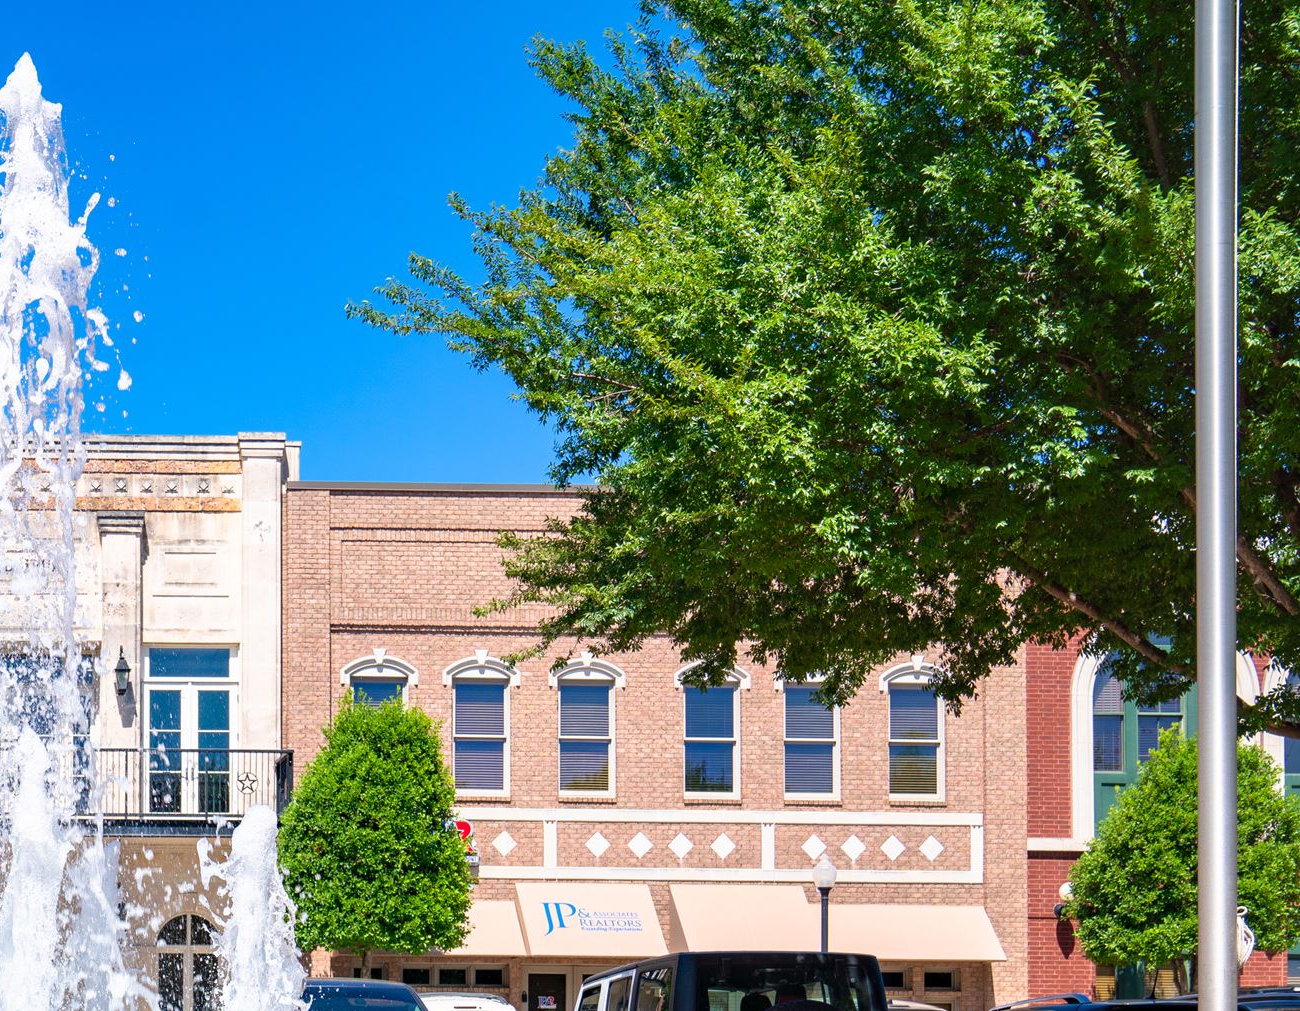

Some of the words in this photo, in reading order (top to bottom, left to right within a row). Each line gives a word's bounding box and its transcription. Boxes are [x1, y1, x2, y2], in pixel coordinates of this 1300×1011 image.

[540, 902, 577, 937] JP
[578, 908, 591, 919] &
[580, 918, 642, 927] REALTORS
